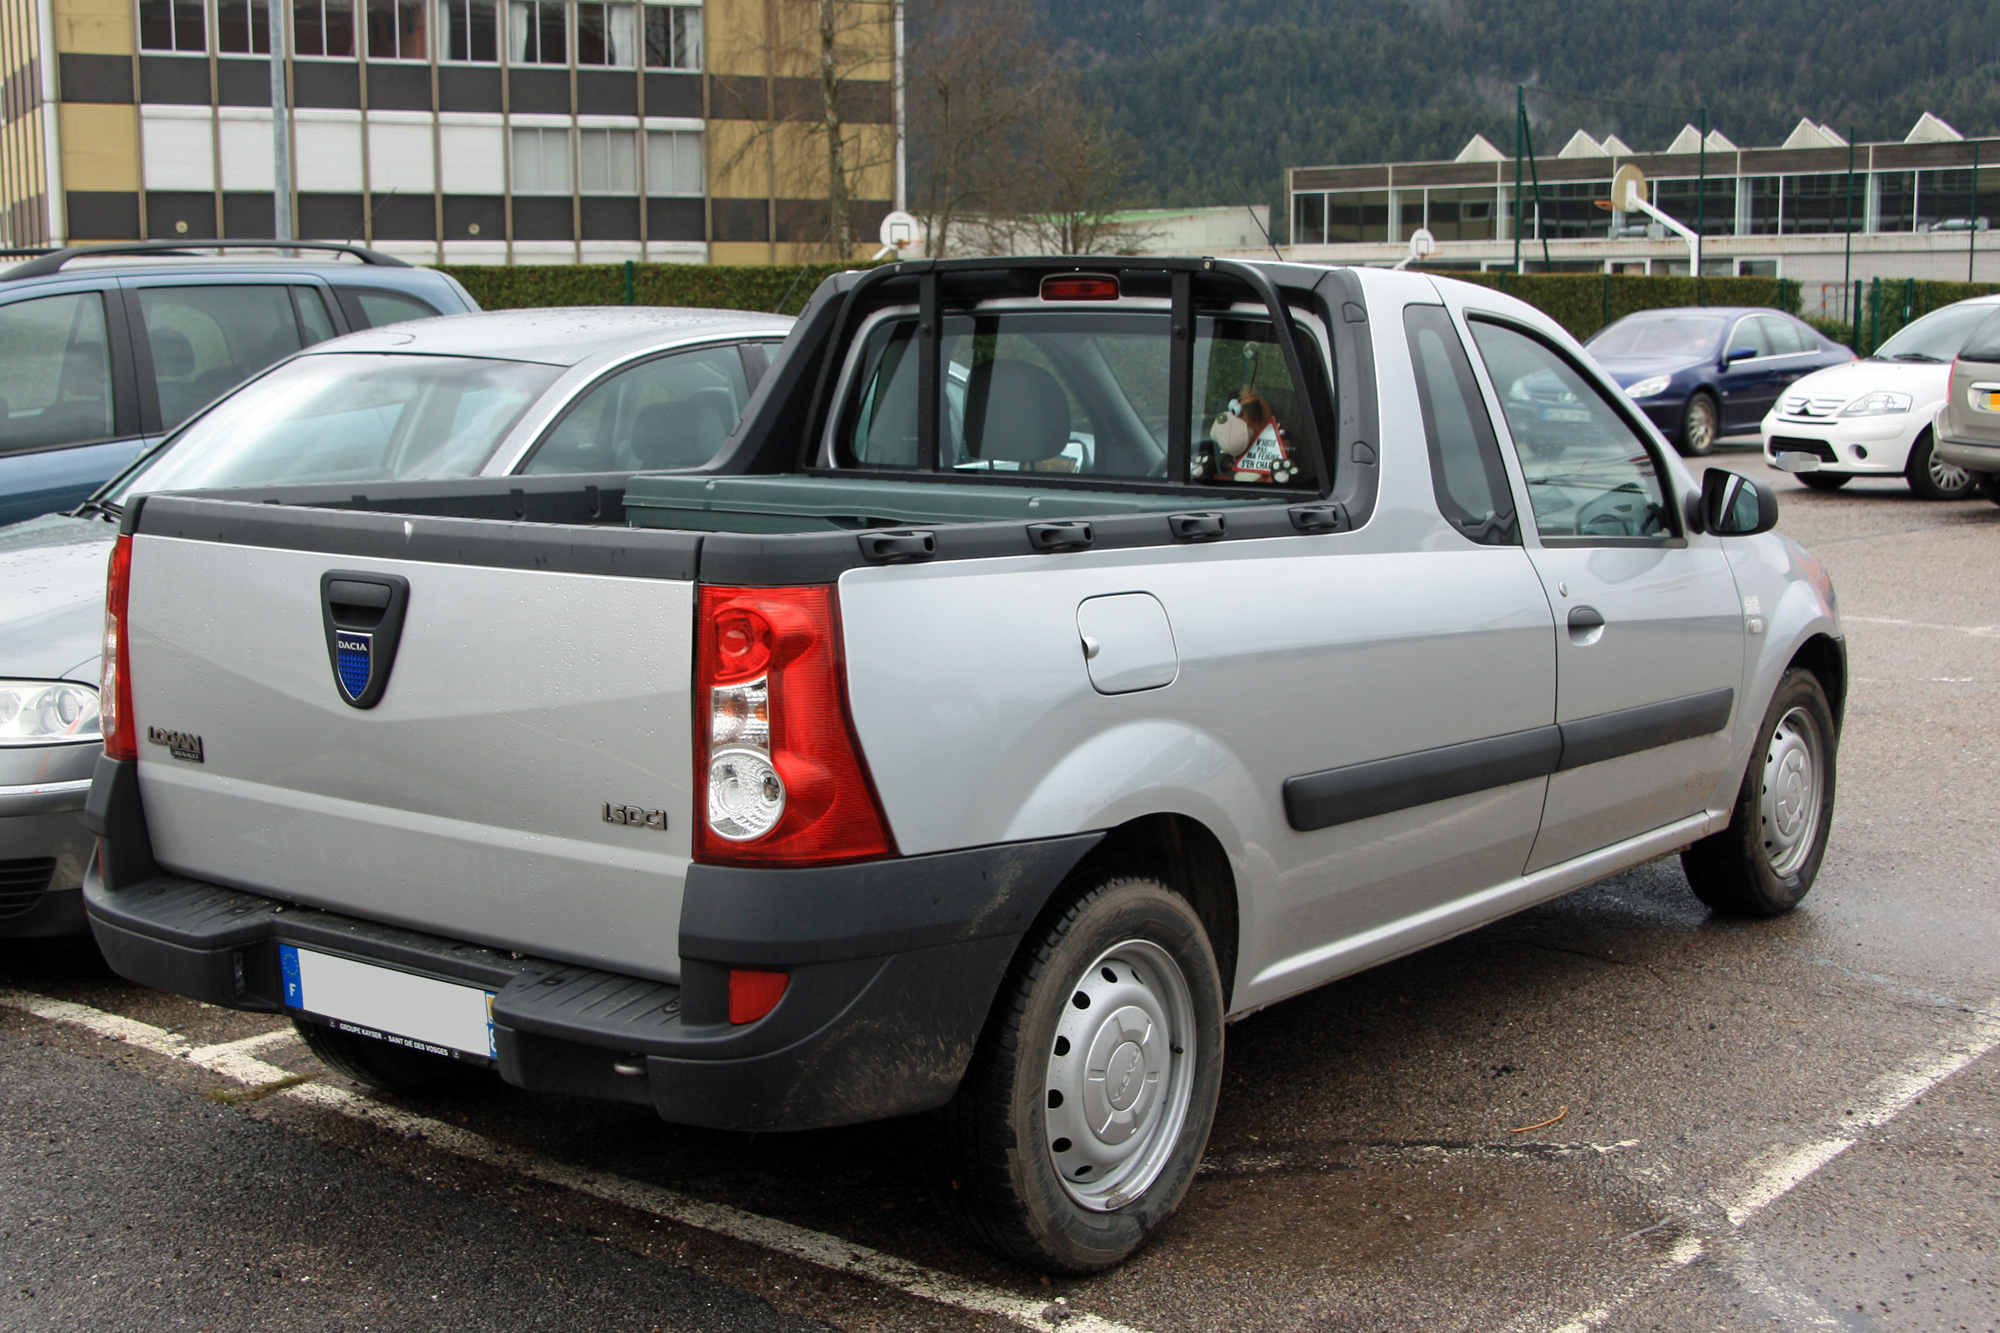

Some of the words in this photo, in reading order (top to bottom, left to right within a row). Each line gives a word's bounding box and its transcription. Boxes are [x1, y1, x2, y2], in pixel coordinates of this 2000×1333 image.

[1241, 459, 1255, 468] S'EN
[338, 640, 368, 652] DACIA
[147, 725, 203, 753] LOGAN
[289, 982, 297, 997] F
[339, 1022, 361, 1035] GROUPE
[361, 1028, 382, 1040] KAYSER
[387, 1035, 404, 1046] SAINT
[404, 1039, 414, 1048] DIÉ
[413, 1041, 425, 1051] DES
[425, 1044, 449, 1057] VOSGES
[1111, 1047, 1141, 1102] DACIA
